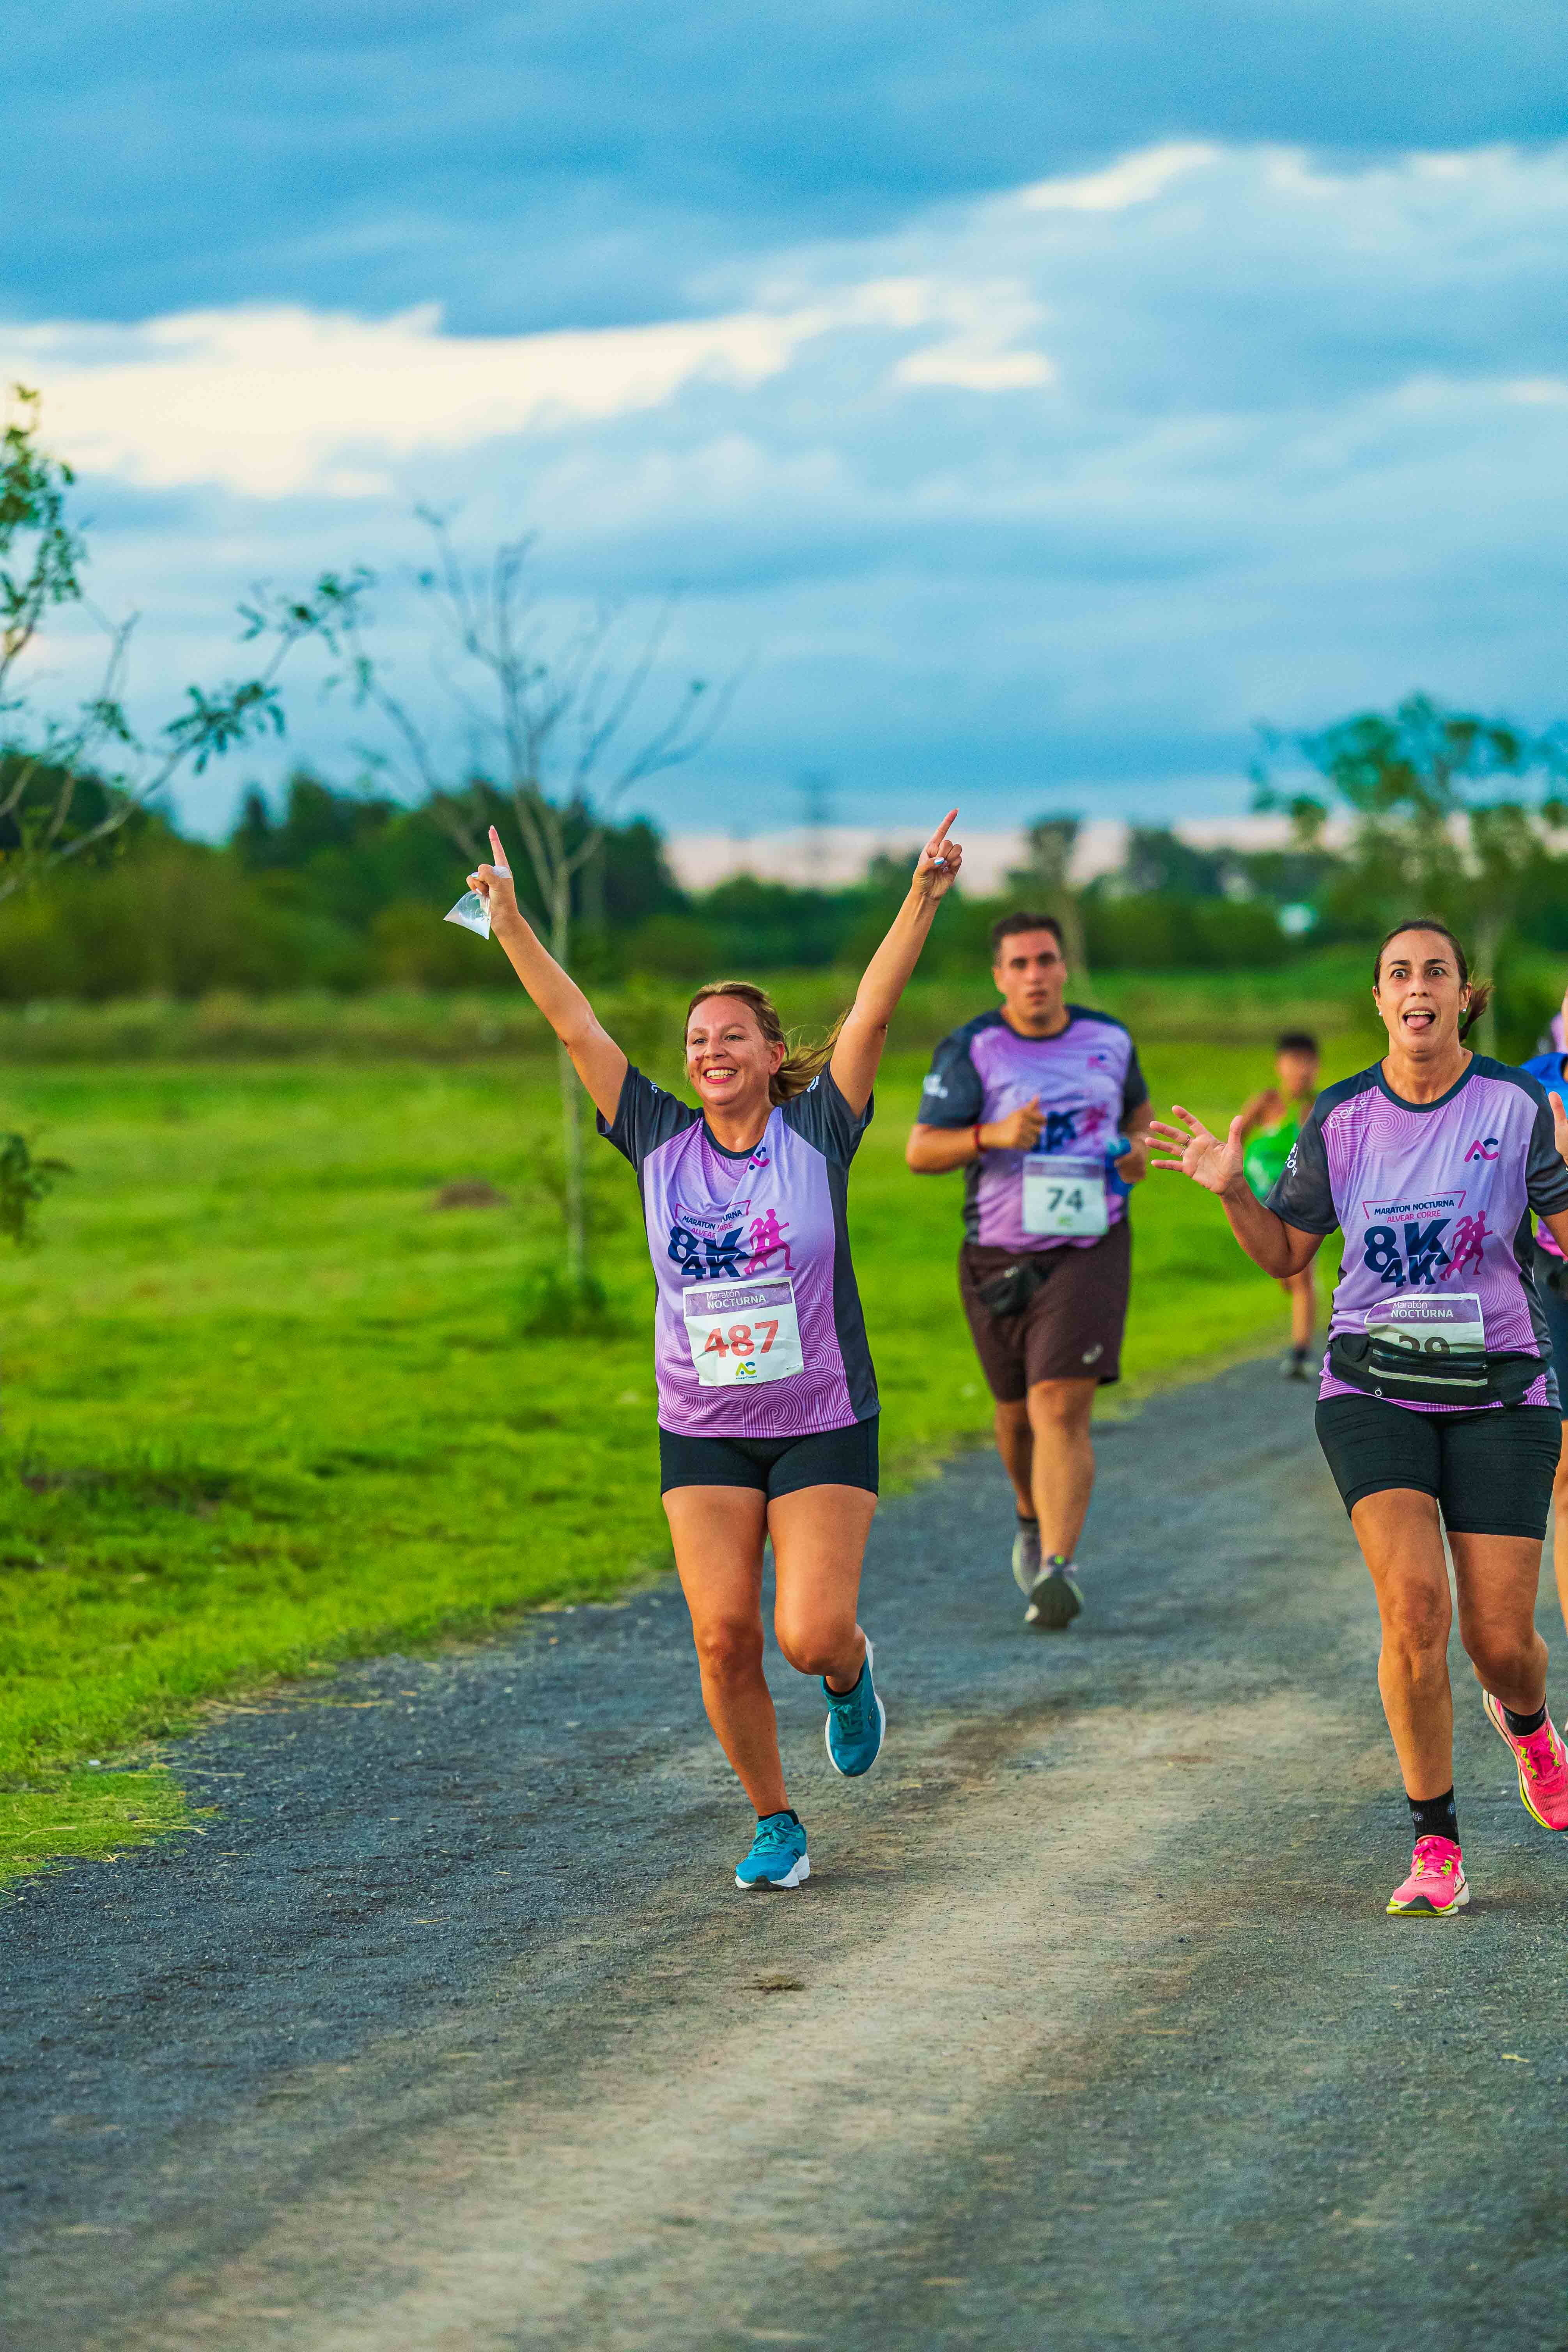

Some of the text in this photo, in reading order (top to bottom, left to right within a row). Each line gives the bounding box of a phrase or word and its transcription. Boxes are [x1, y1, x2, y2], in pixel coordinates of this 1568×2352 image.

[1464, 1138, 1499, 1162] AC
[1047, 1187, 1084, 1213] 74
[1374, 1199, 1455, 1215] MARATON NOCTURNA
[682, 1215, 716, 1230] MARATON
[1387, 1210, 1441, 1223] ALVEAR CORRE
[668, 1226, 753, 1264] 8K
[1364, 1219, 1451, 1273] 8K
[681, 1254, 741, 1280] 4K
[1380, 1254, 1437, 1288] 4K
[707, 1289, 740, 1300] Maratón
[707, 1294, 766, 1309] NOCTURNA
[1393, 1300, 1428, 1309] Maratón
[1391, 1309, 1454, 1318] NOCTURNA
[705, 1320, 779, 1357] 487
